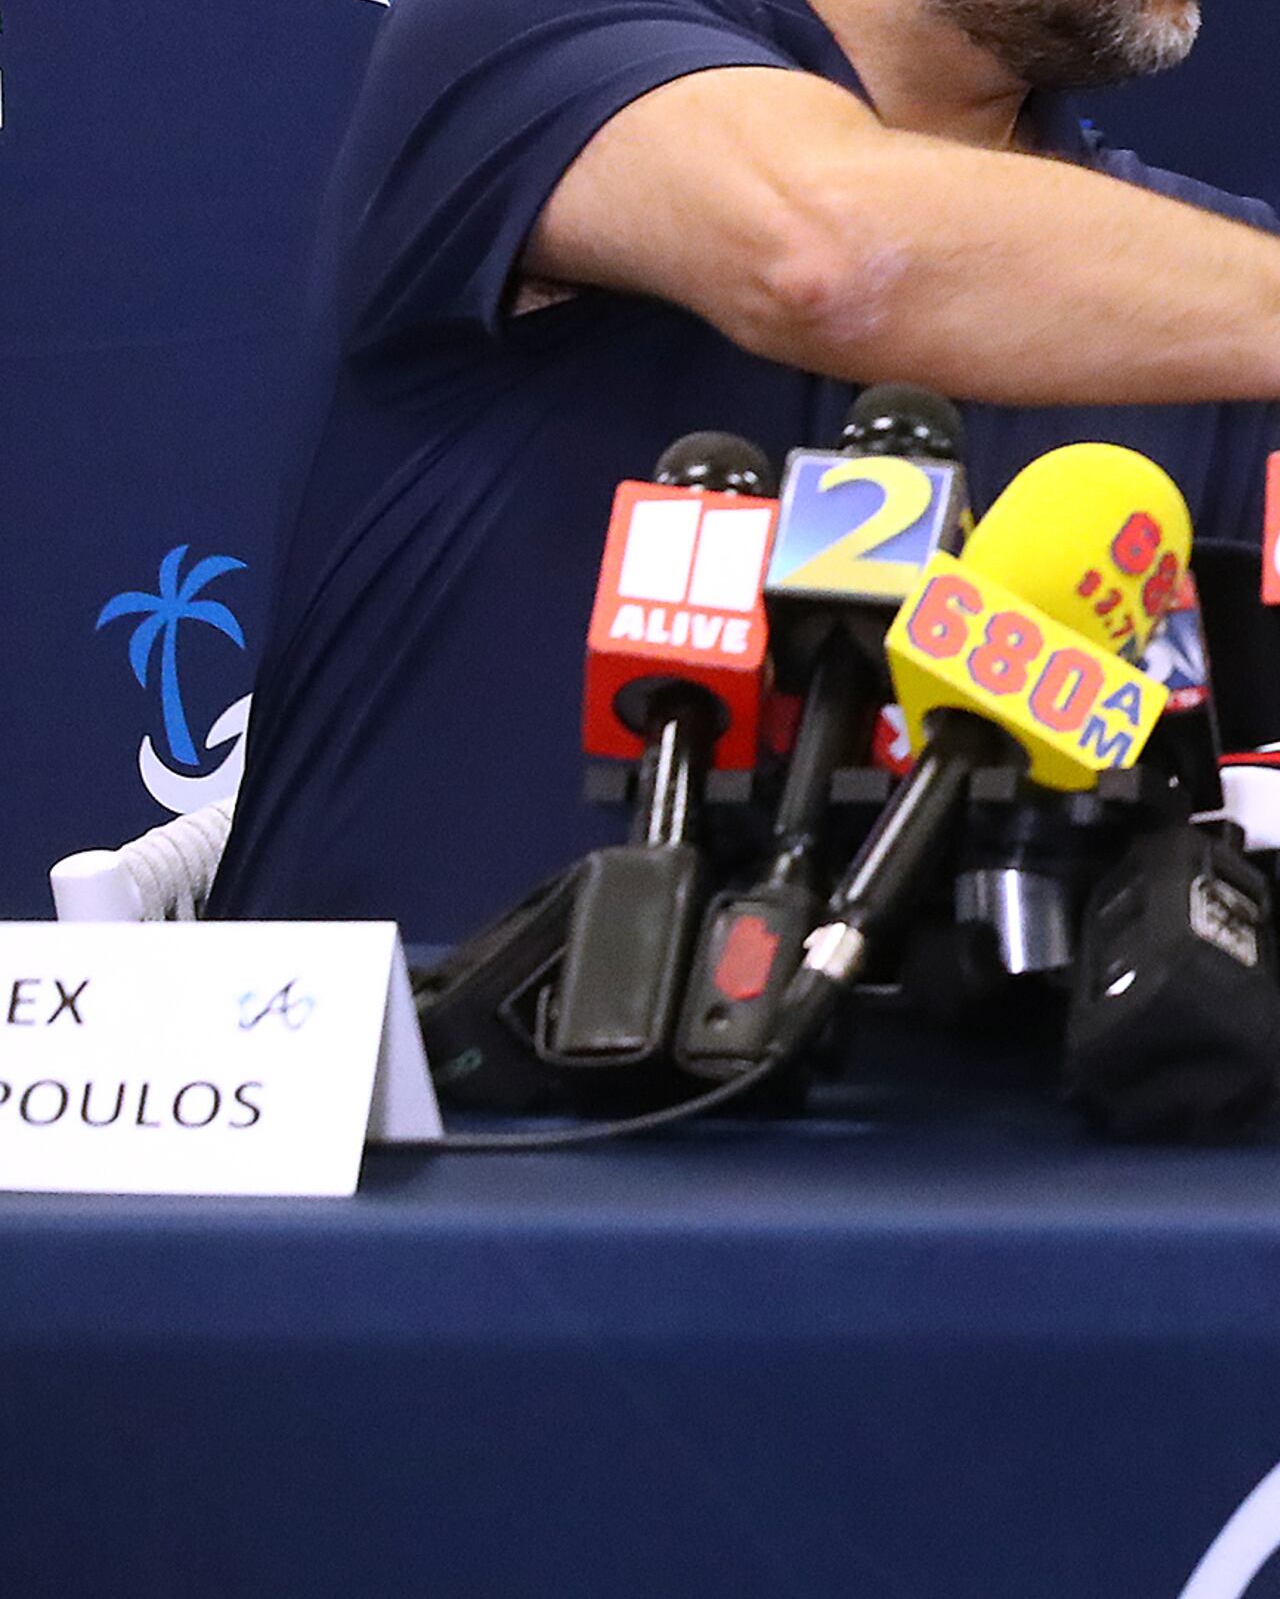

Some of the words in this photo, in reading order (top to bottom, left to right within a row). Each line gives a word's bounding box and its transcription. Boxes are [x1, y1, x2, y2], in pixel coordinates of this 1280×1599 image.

[775, 456, 931, 587] 2
[610, 604, 751, 654] ALIVE
[906, 572, 1105, 732] 680
